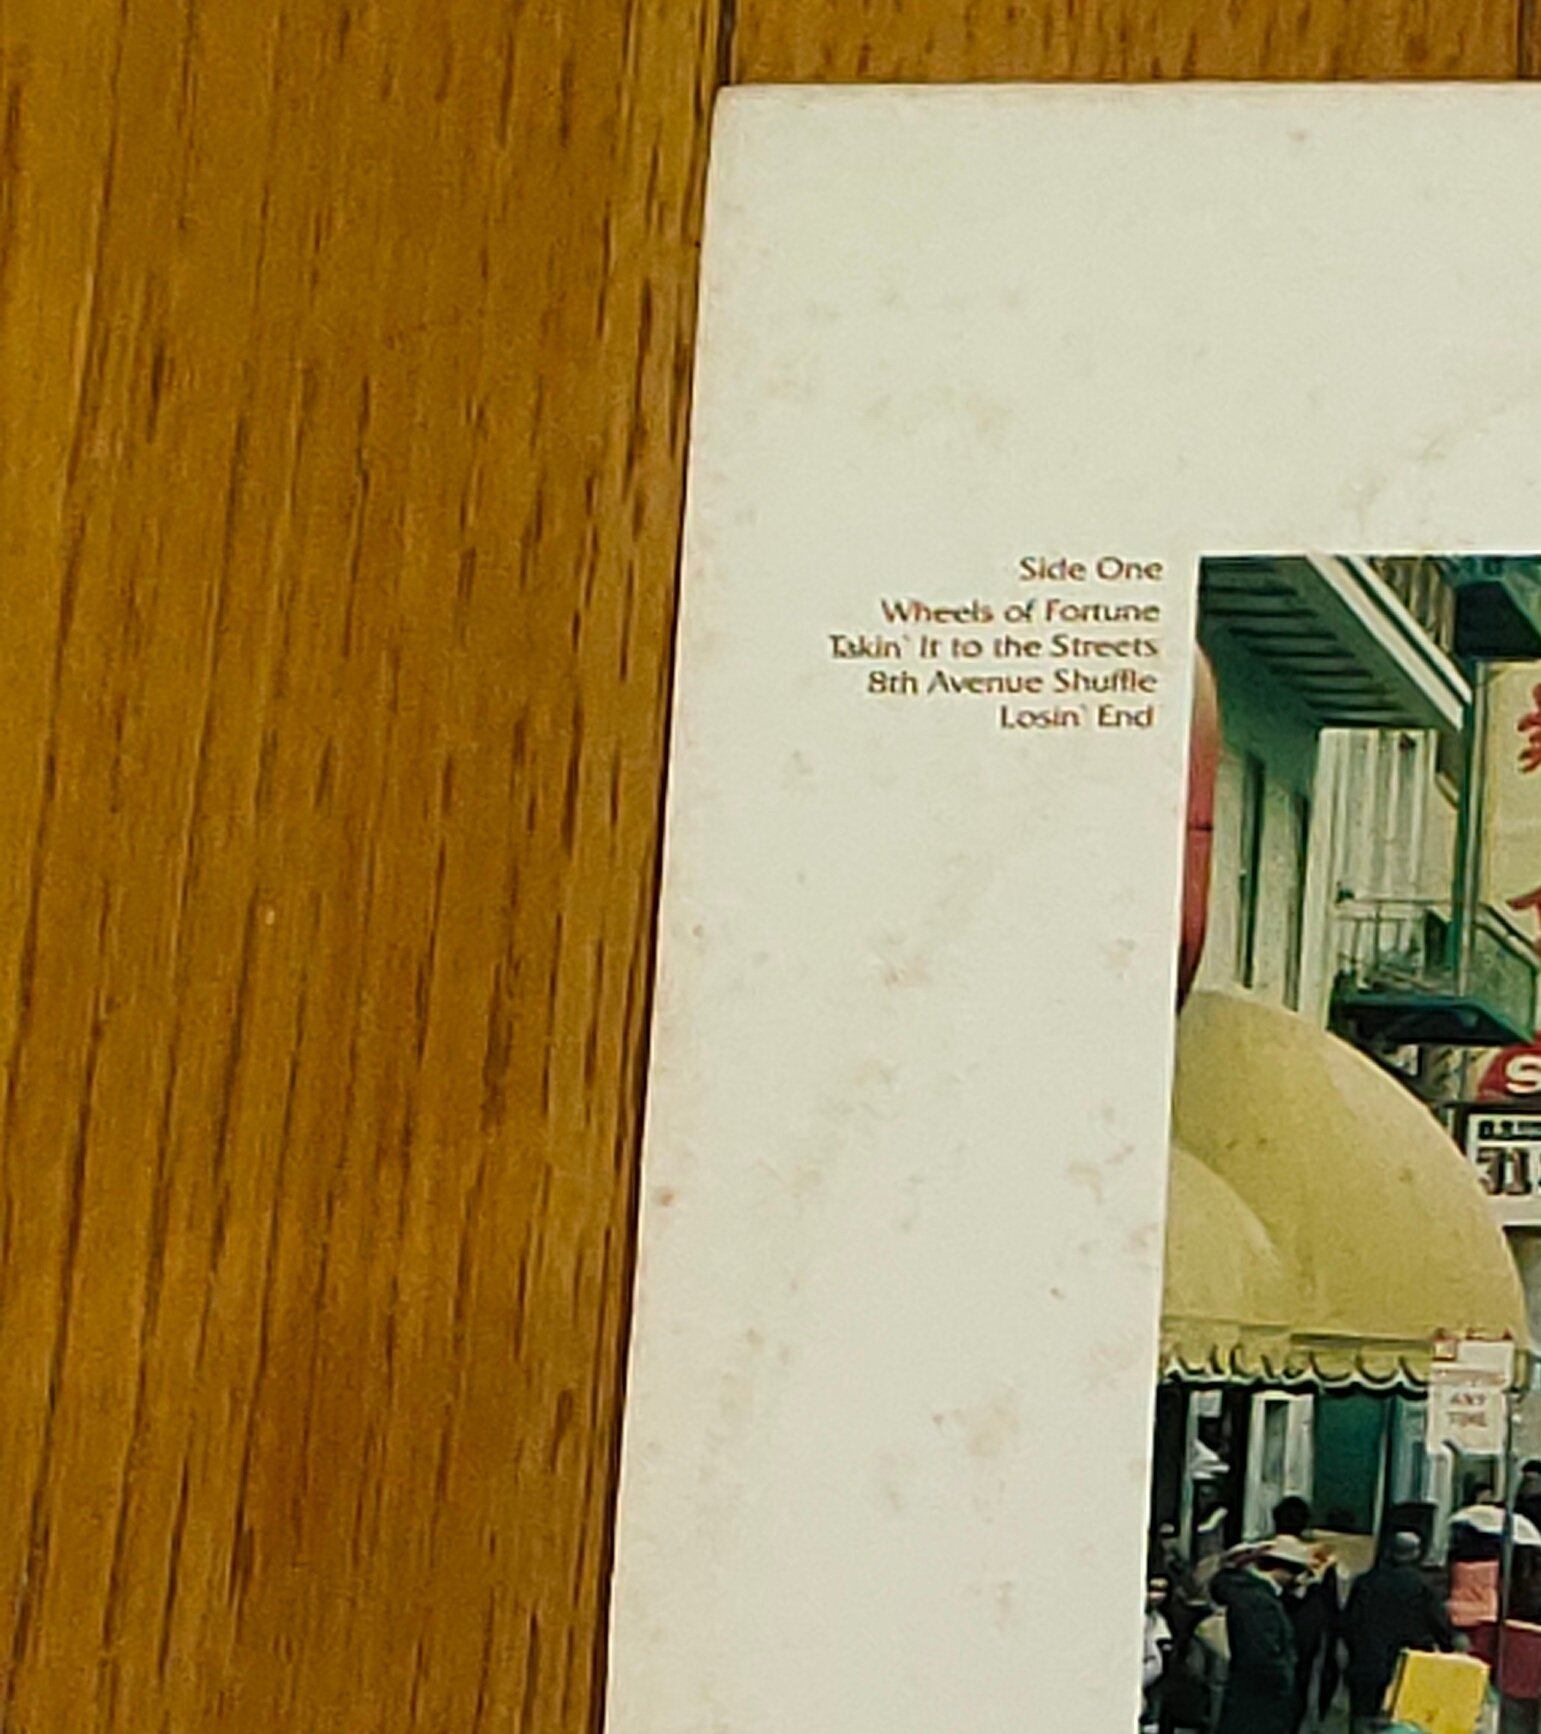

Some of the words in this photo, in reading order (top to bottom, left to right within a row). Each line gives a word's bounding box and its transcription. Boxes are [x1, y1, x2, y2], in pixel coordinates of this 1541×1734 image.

[1018, 555, 1087, 582] Side
[1096, 555, 1164, 581] One
[880, 599, 994, 624] Wheels
[1003, 599, 1036, 624] of
[1044, 599, 1161, 623] Fortune
[919, 634, 942, 658] It
[950, 635, 983, 658] to
[992, 633, 1042, 658] the
[1050, 633, 1159, 658] Streets
[867, 669, 918, 695] 8th
[926, 670, 1044, 694] Avenue
[1052, 668, 1159, 694] Shuffle
[1096, 703, 1154, 728] End
